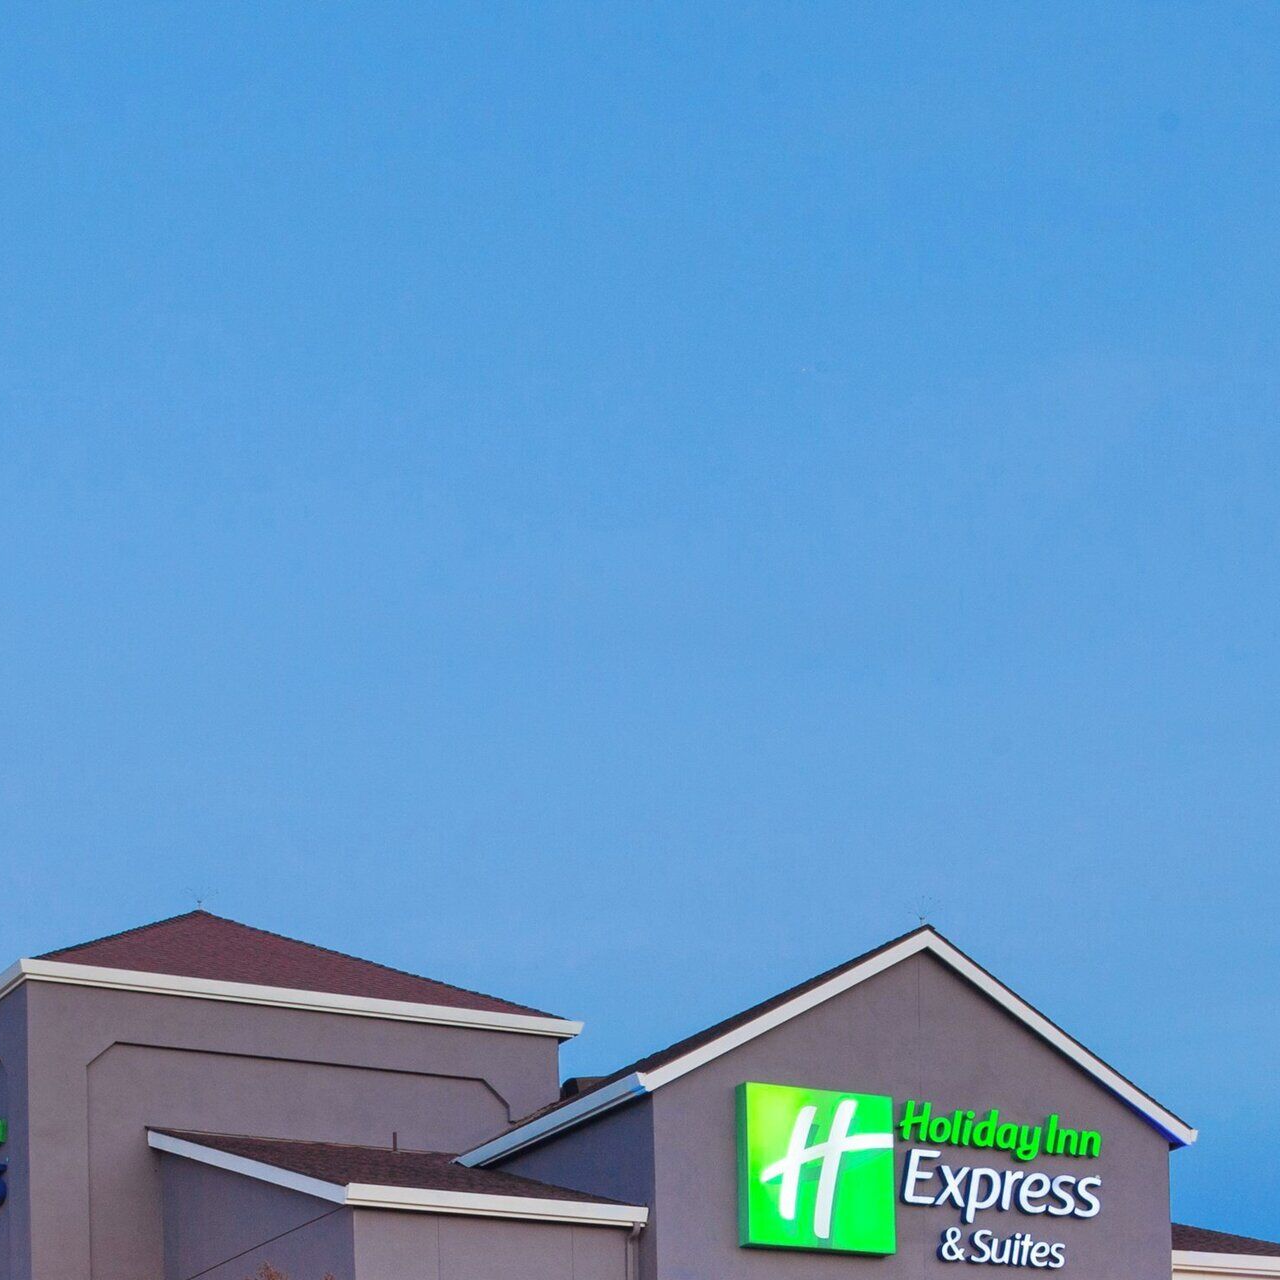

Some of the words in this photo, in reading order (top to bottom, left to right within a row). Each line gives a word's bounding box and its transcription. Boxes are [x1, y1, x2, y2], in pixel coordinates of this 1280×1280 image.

[900, 1100, 1041, 1160] Holiday
[1049, 1114, 1102, 1158] Inn
[902, 1149, 1101, 1223] Express
[940, 1227, 965, 1262] &
[971, 1229, 1065, 1268] Suites
